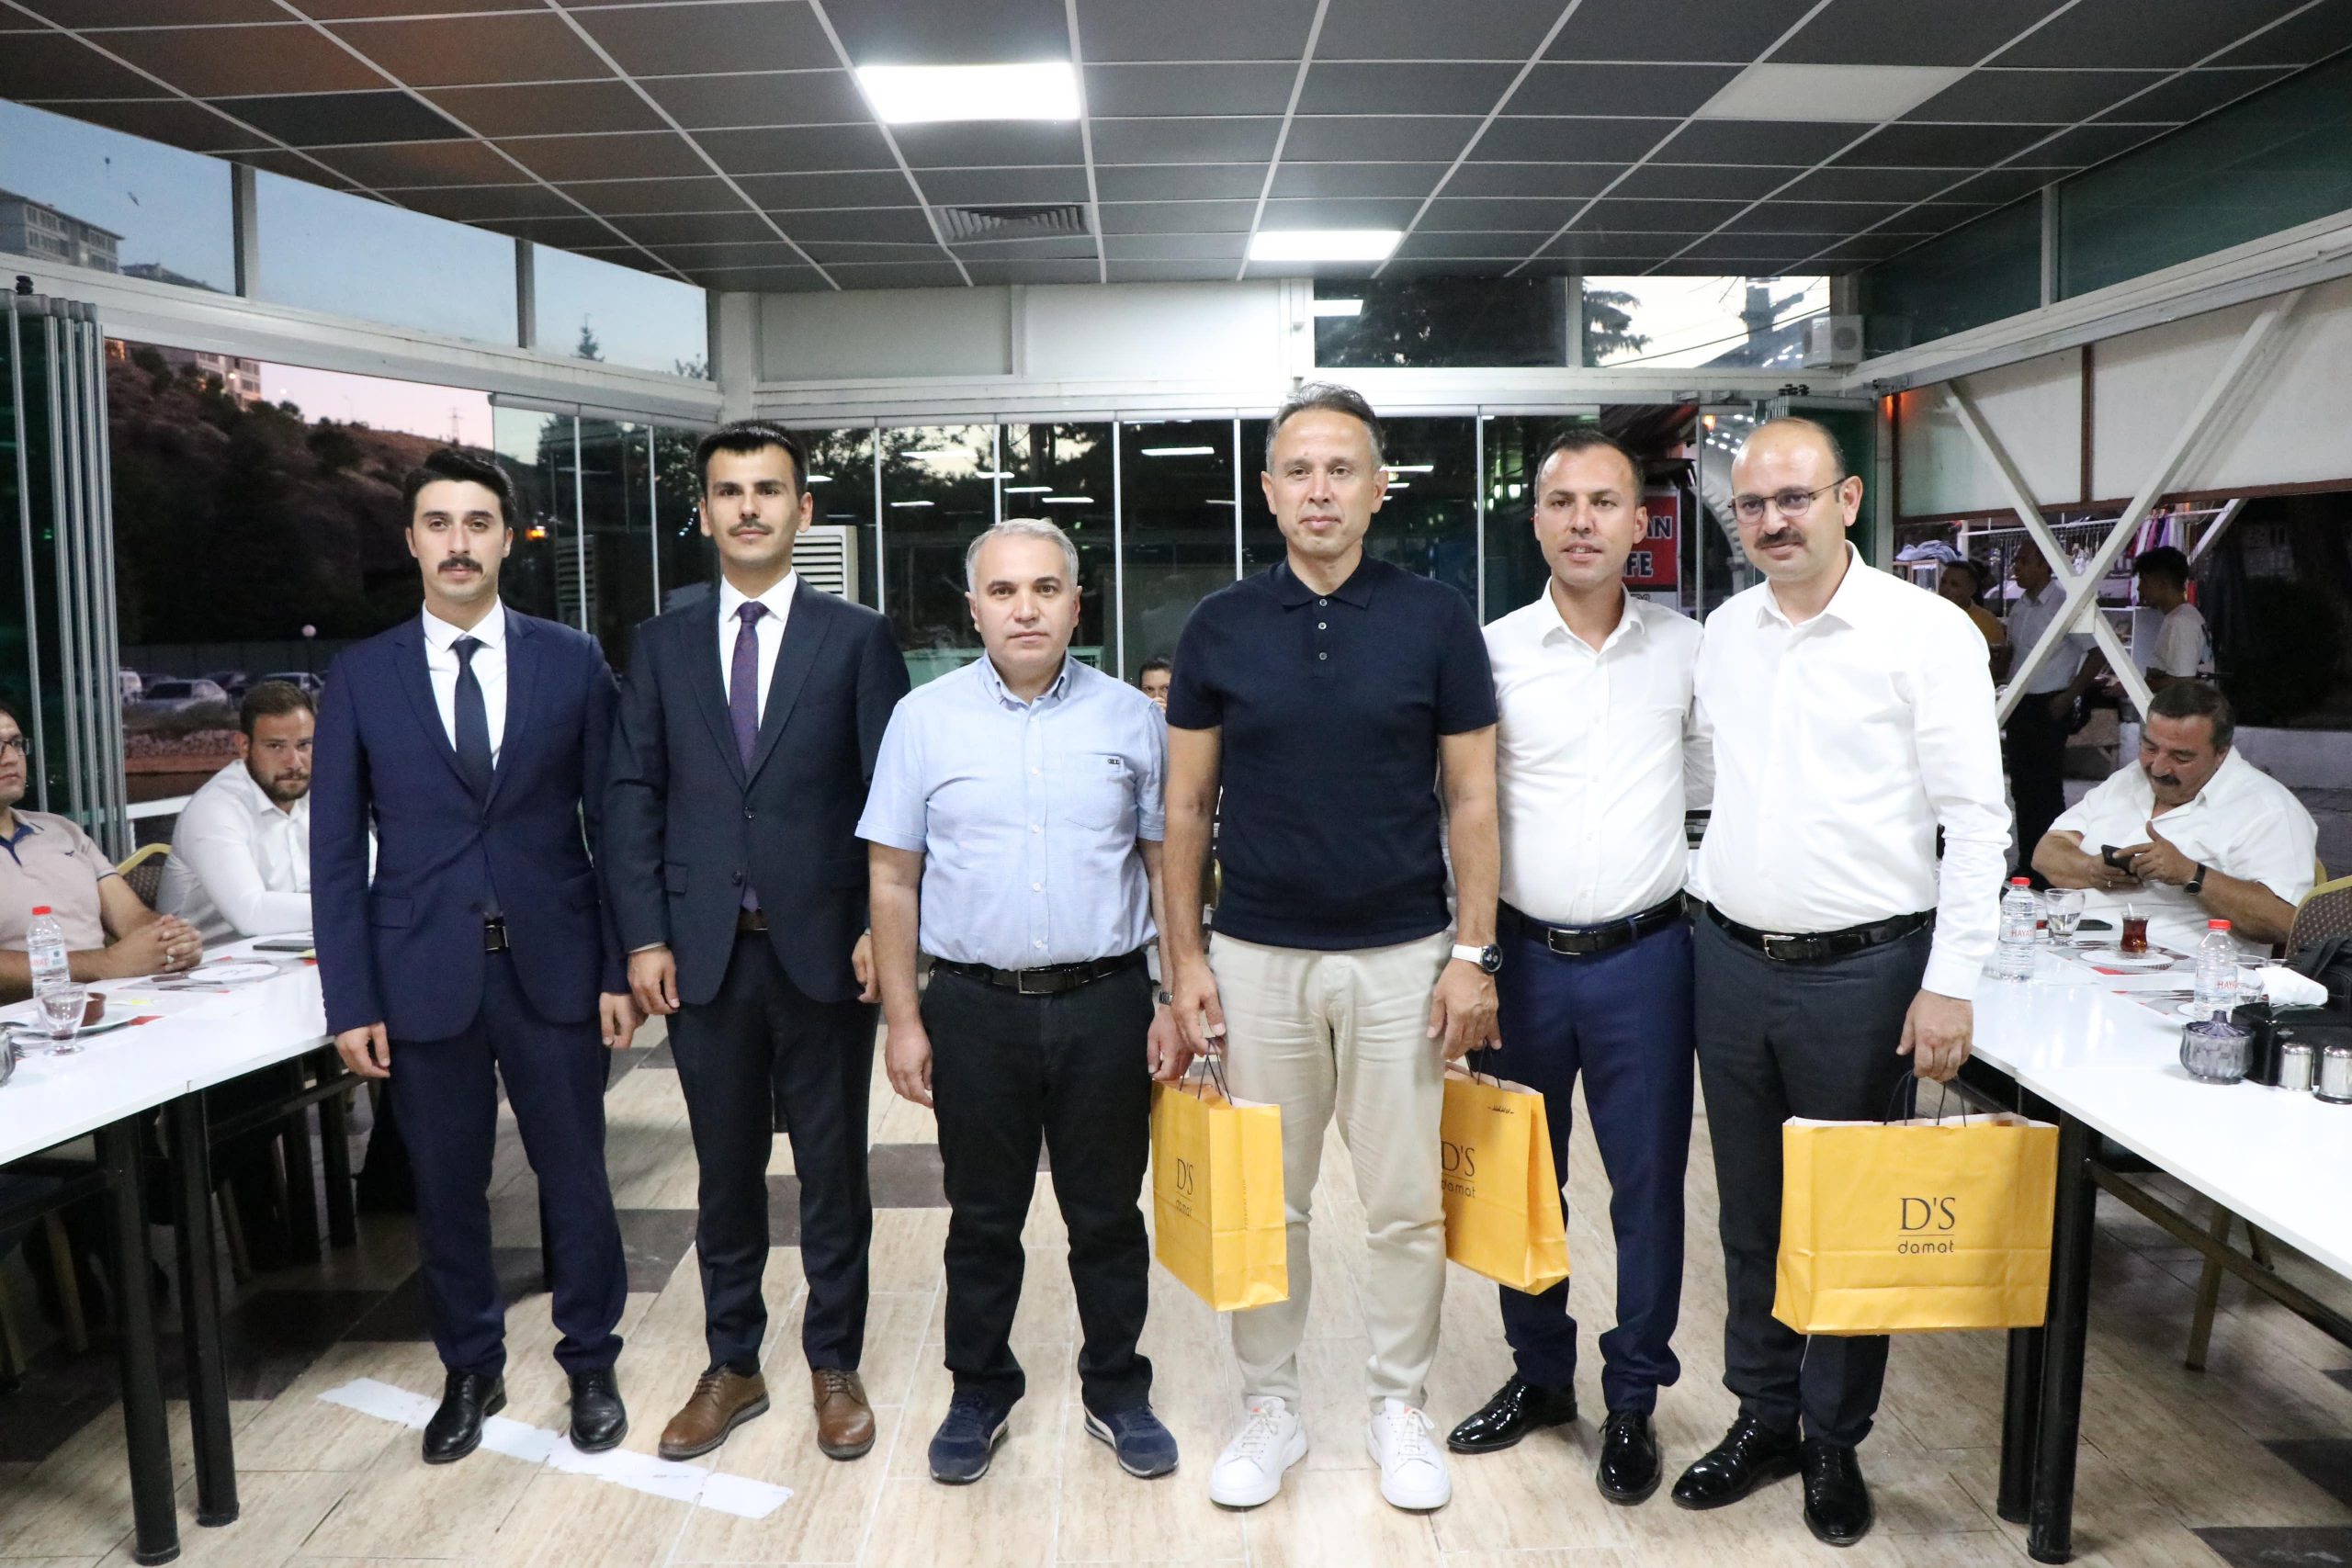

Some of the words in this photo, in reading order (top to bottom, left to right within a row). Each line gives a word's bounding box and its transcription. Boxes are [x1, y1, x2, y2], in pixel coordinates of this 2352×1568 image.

[1623, 551, 1653, 577] FE
[1441, 1141, 1475, 1177] D'S
[1177, 1157, 1193, 1195] D'S
[1442, 1179, 1476, 1198] damat
[1899, 1197, 1956, 1230] D'S
[1897, 1239, 1954, 1254] damat
